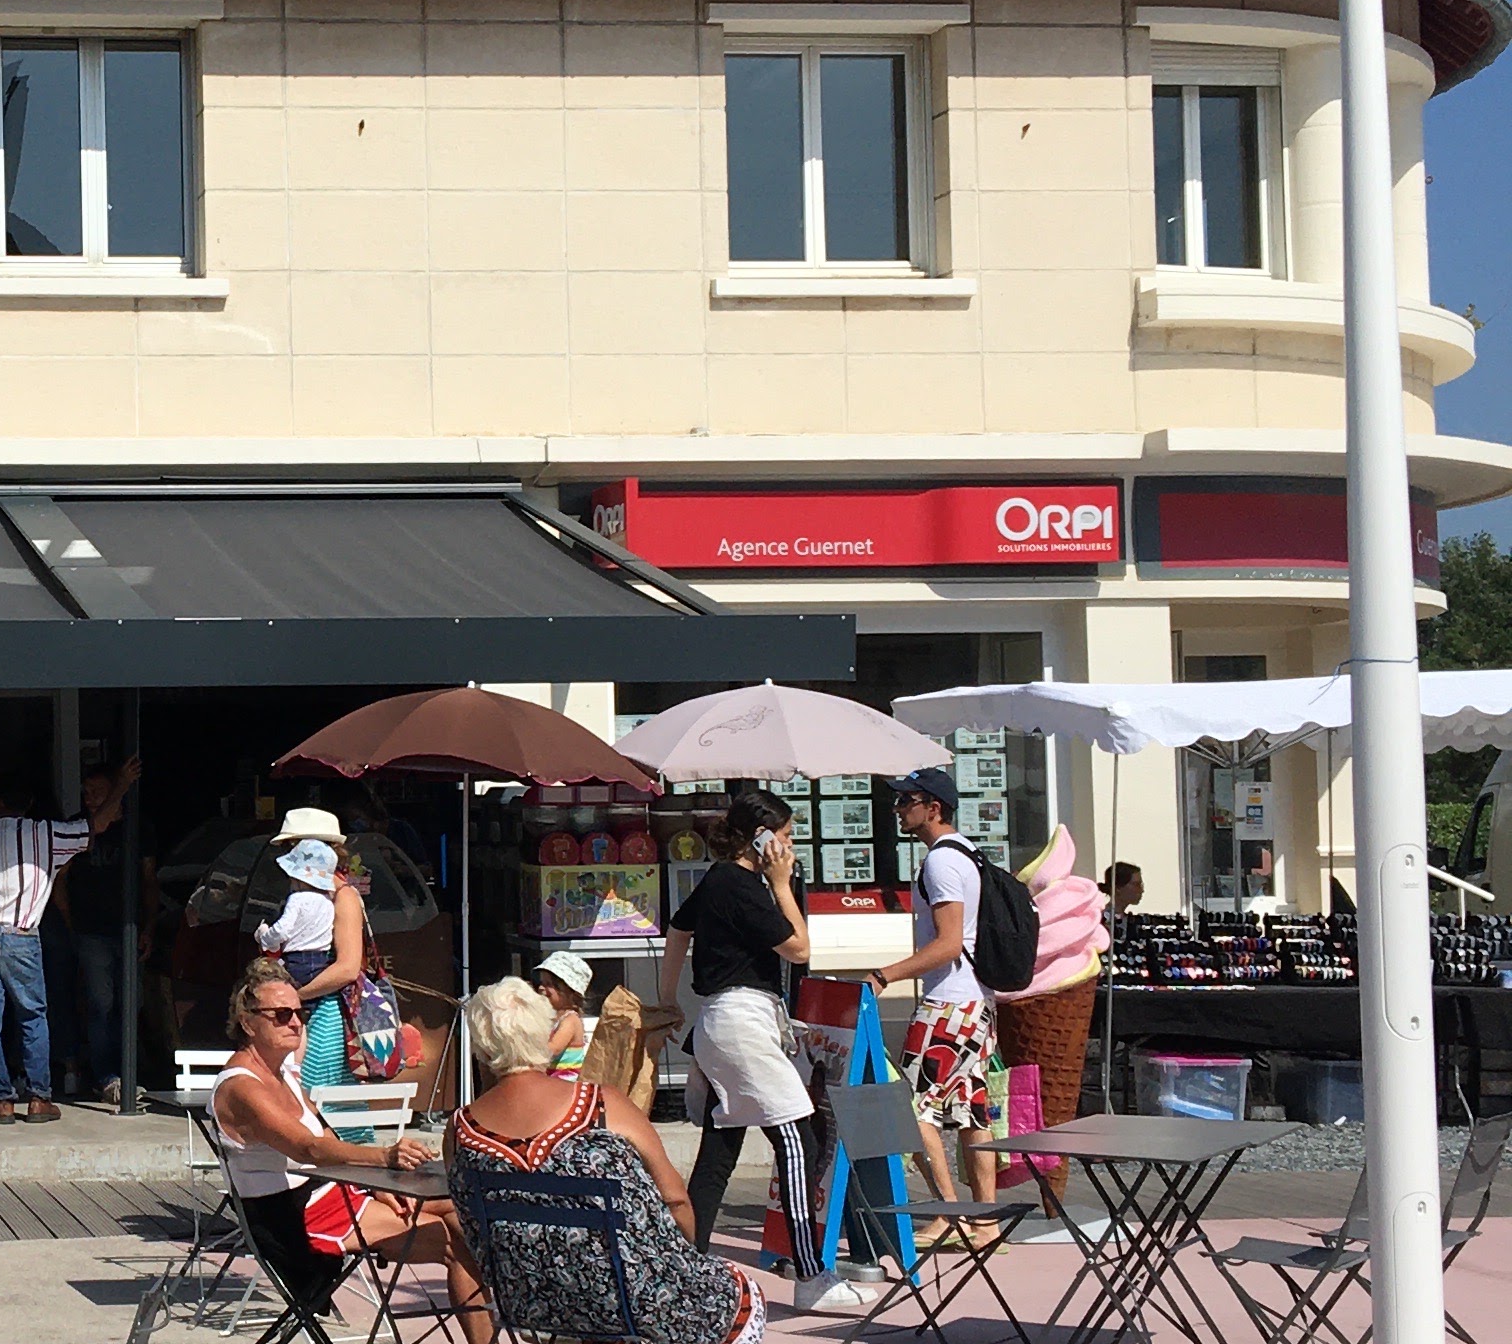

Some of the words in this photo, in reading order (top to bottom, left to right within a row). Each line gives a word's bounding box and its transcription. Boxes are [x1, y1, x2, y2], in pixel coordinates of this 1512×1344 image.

[996, 497, 1113, 541] ORPI
[717, 538, 788, 561] Agence
[793, 537, 874, 556] Guernet
[997, 544, 1048, 553] SOLUTIONS
[1051, 542, 1112, 552] IMMOBILIERES
[841, 896, 877, 907] ORPI
